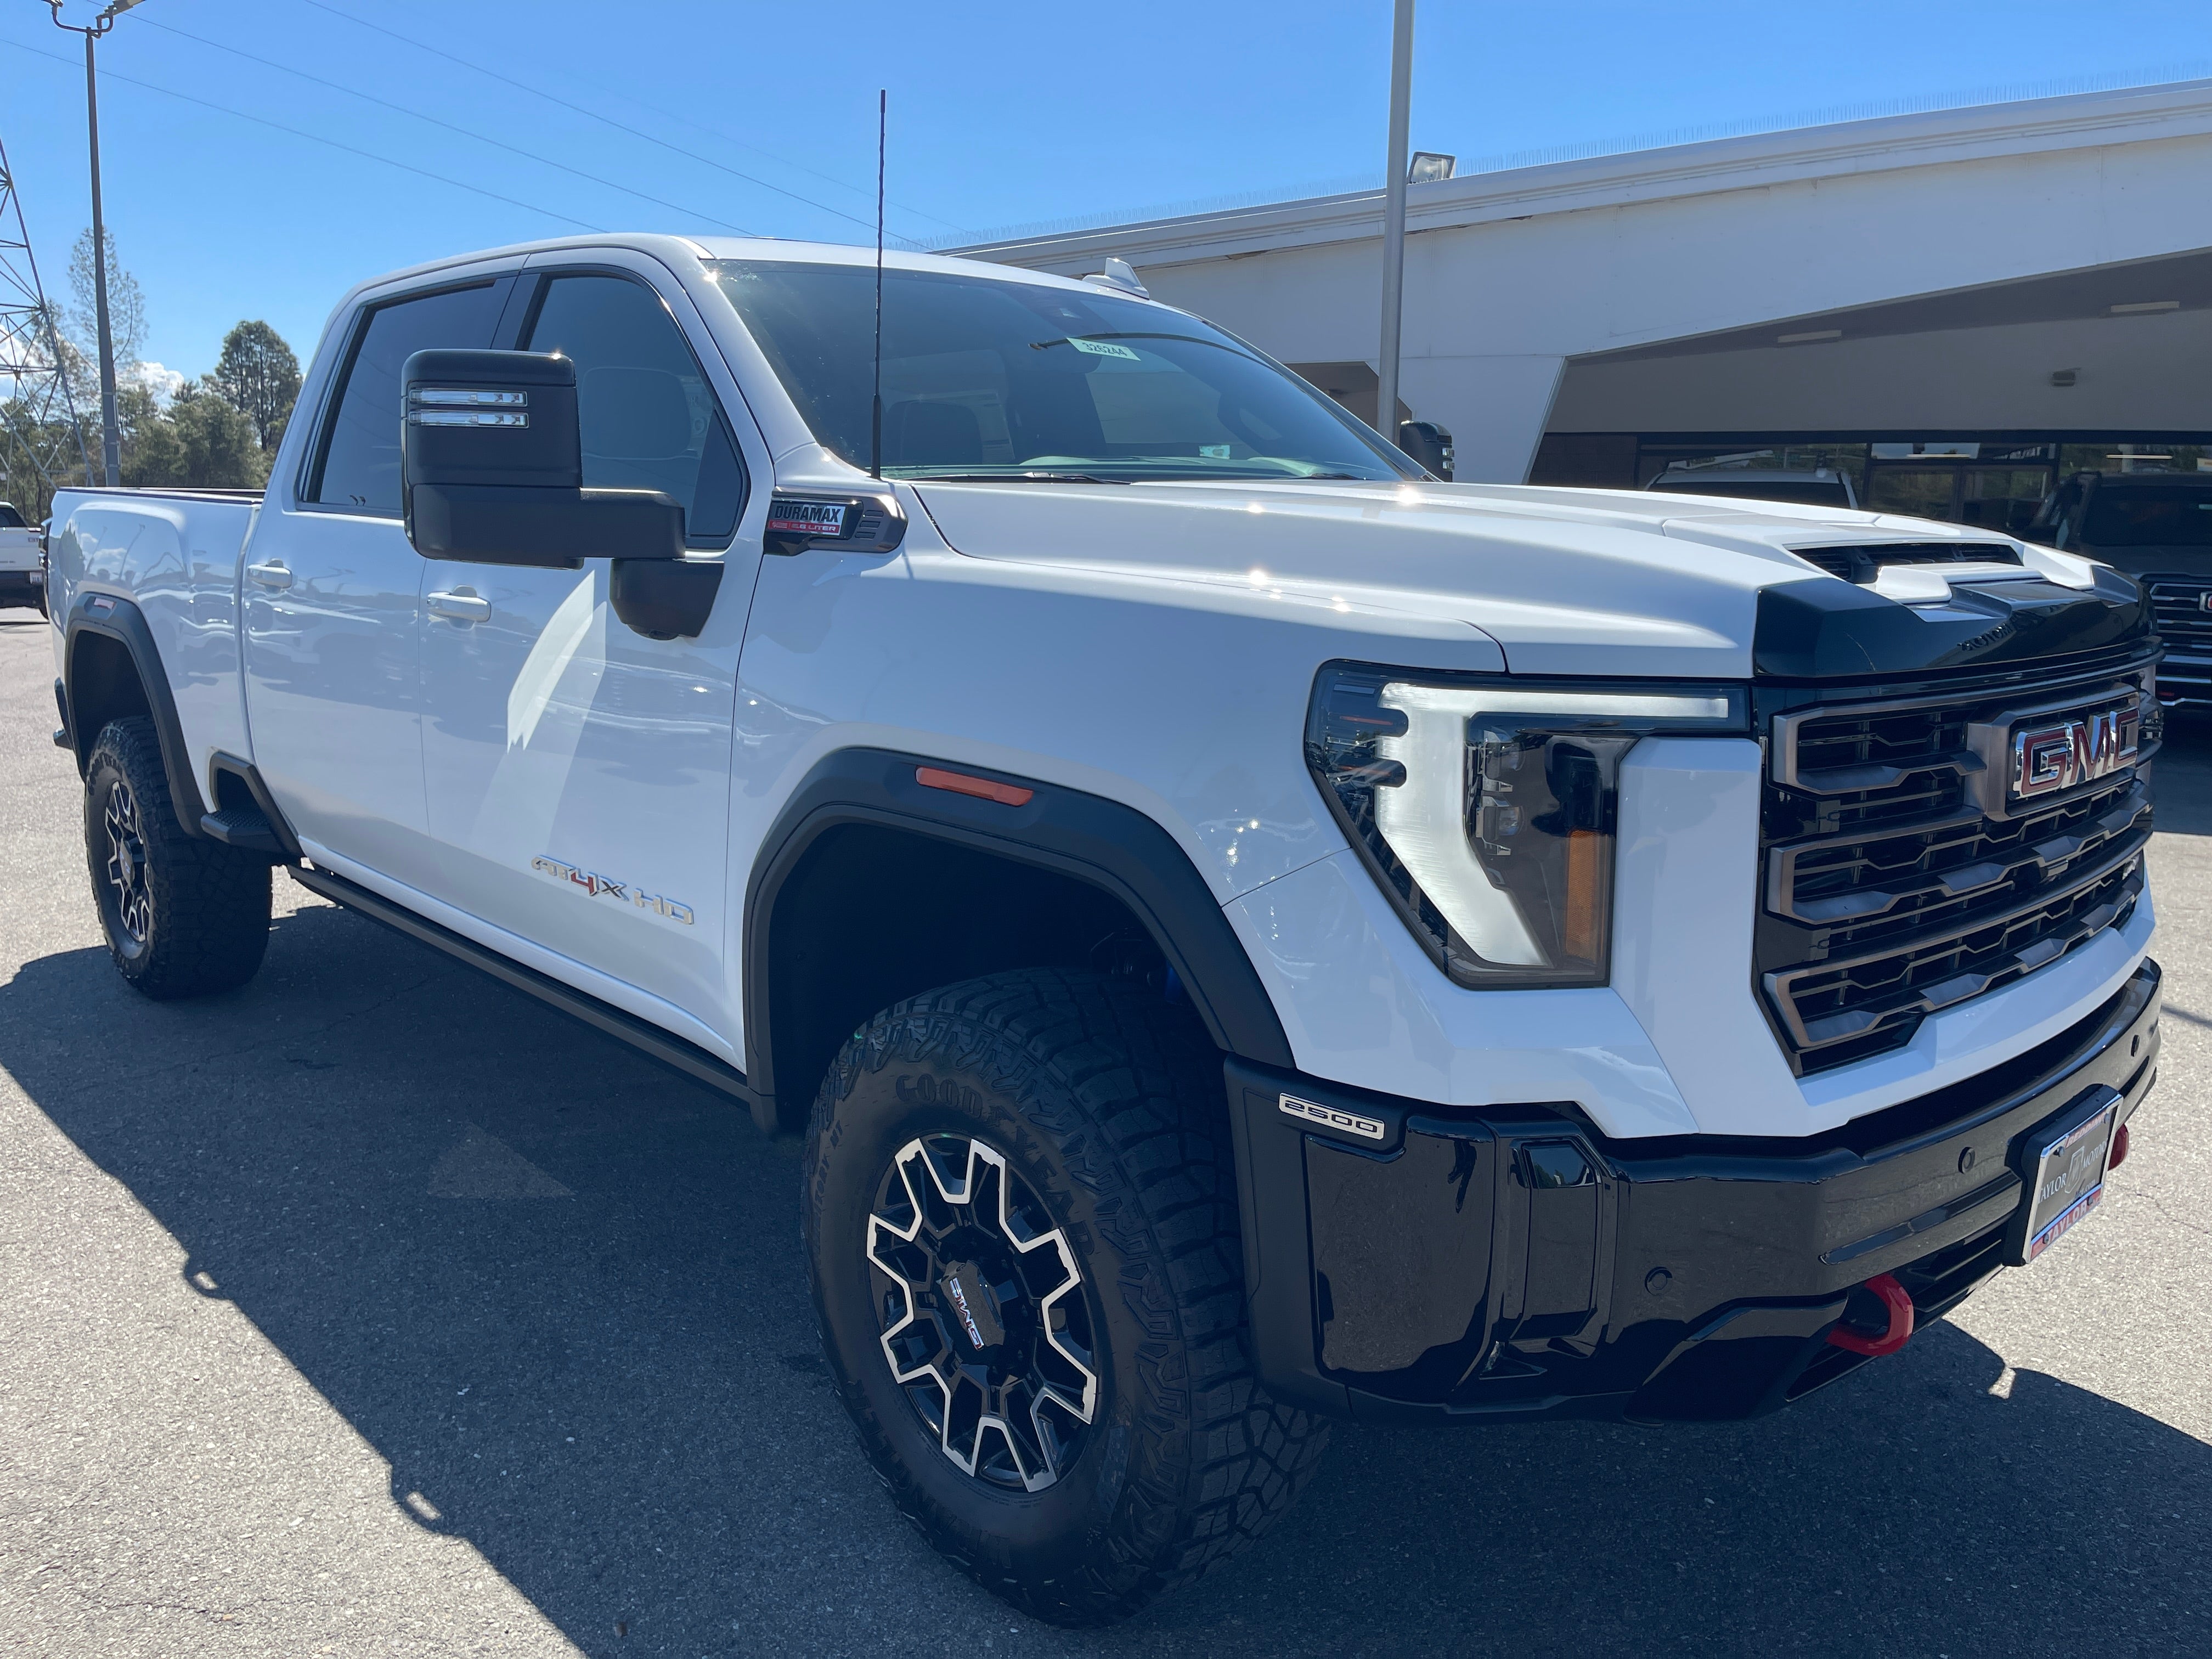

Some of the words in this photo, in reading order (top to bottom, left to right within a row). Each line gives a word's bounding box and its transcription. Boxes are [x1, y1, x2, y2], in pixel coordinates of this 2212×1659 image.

[774, 505, 842, 523] DURAMAX
[2013, 707, 2140, 800] GMC
[531, 854, 630, 902] AT4X
[633, 888, 695, 926] HD
[1284, 1100, 1378, 1133] 2500
[2039, 1172, 2067, 1205] TAYLOR
[2047, 1200, 2087, 1245] TAYLOR
